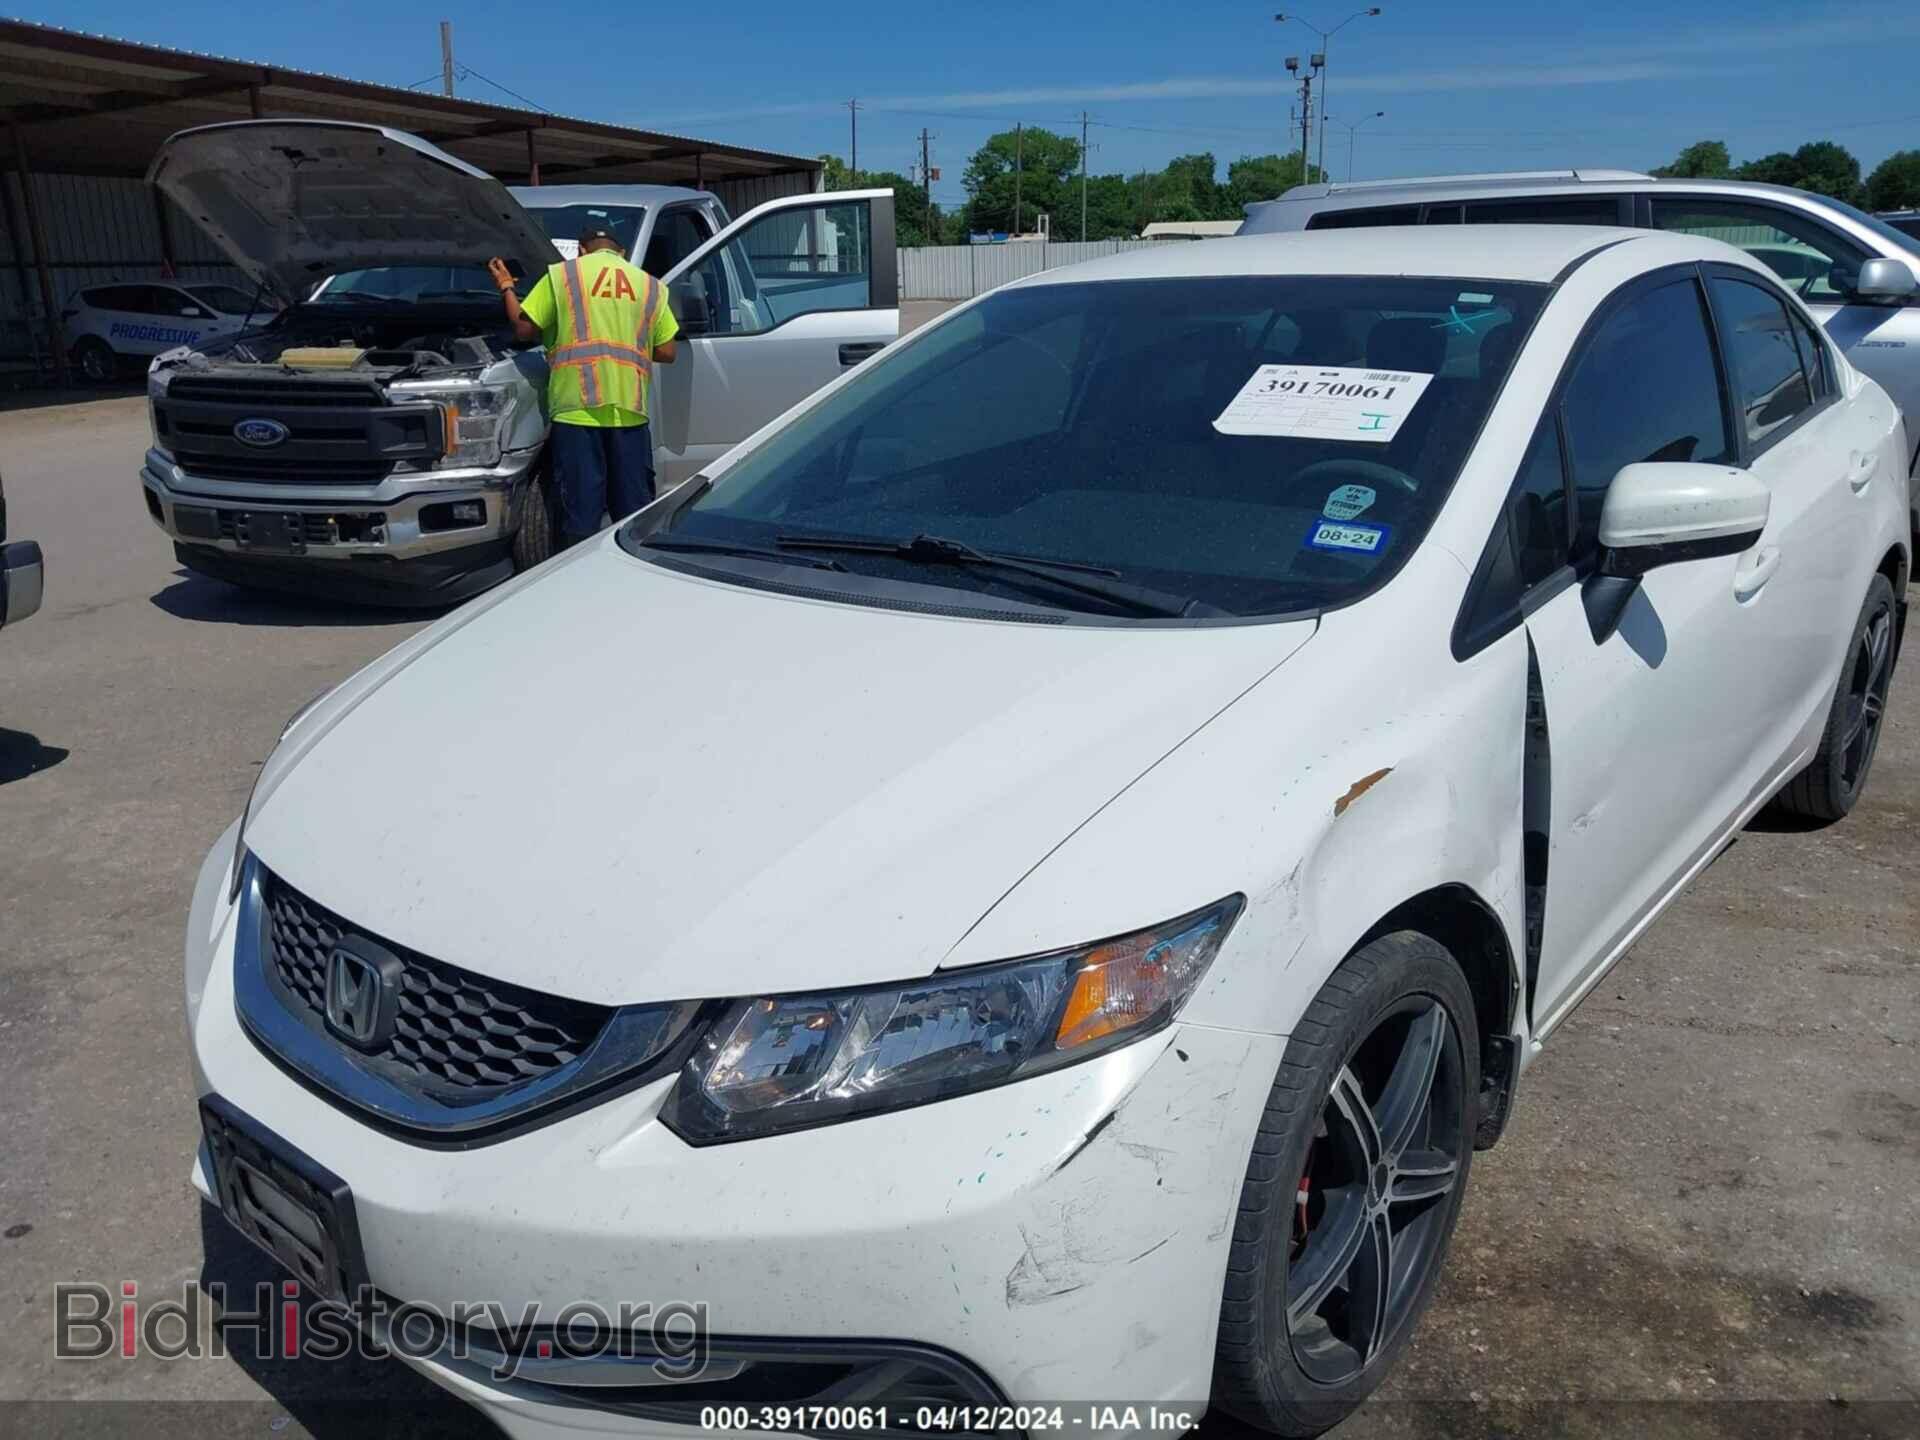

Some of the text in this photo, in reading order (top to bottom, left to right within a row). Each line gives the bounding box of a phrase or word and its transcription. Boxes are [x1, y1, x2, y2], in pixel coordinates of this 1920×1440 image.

[109, 322, 201, 344] PROGRESSIVE
[1258, 378, 1397, 401] 39170061
[1318, 529, 1376, 545] 08 24
